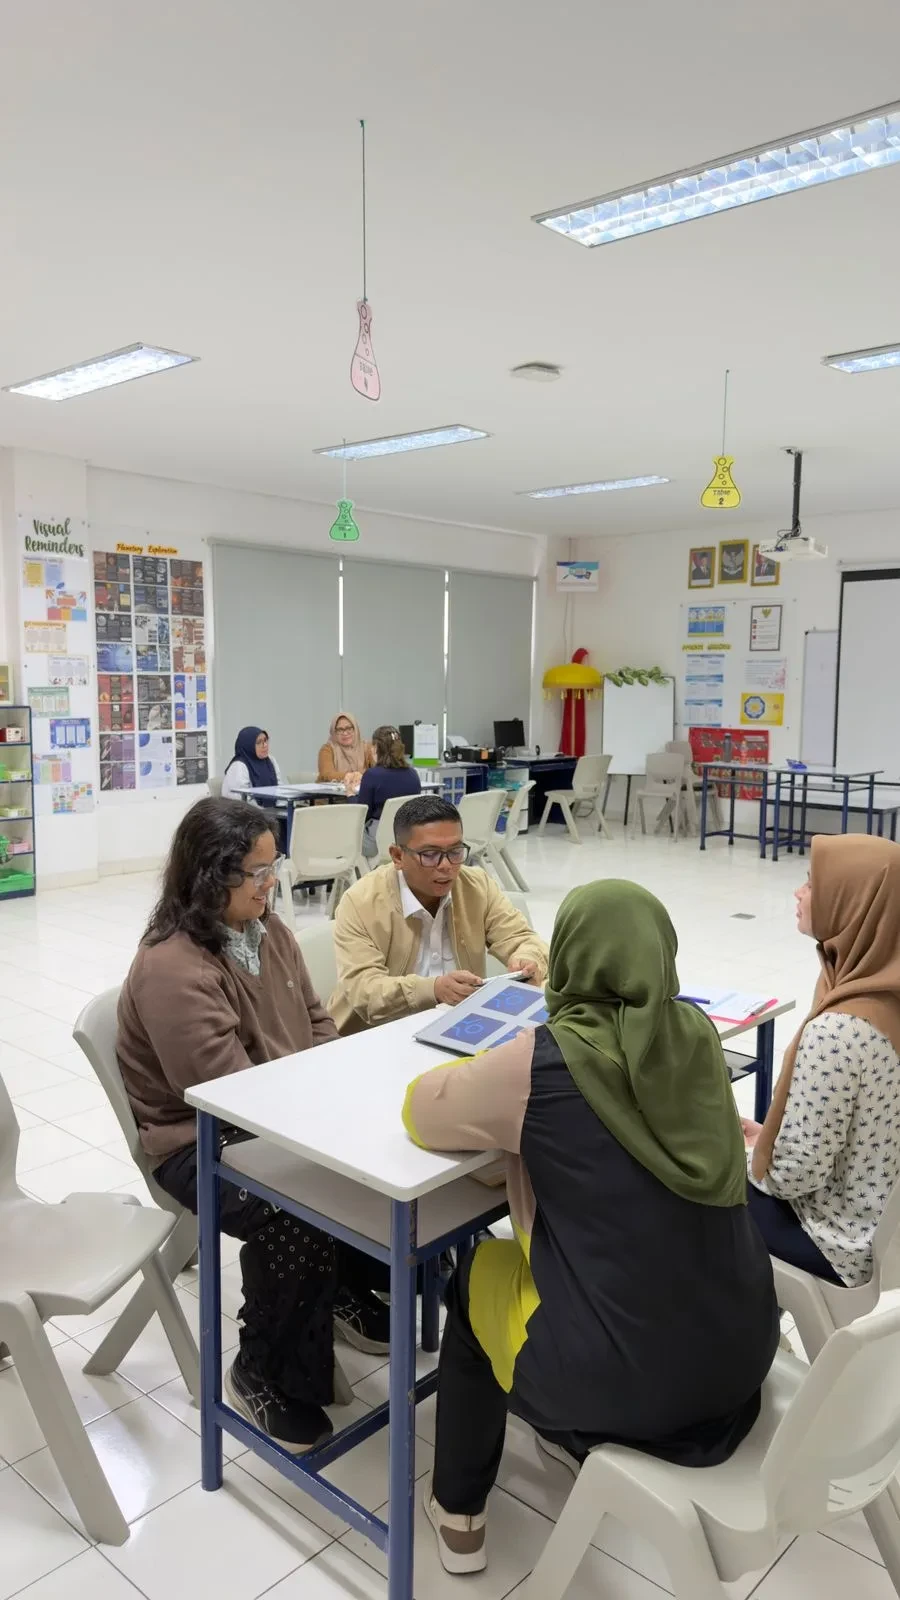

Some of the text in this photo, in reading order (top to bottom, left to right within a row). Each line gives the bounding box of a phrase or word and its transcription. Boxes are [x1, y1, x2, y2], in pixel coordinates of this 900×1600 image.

[718, 497, 725, 505] 2
[33, 517, 72, 537] Visual
[24, 535, 84, 557] Reminders
[116, 543, 178, 555] Planetary Exploration
